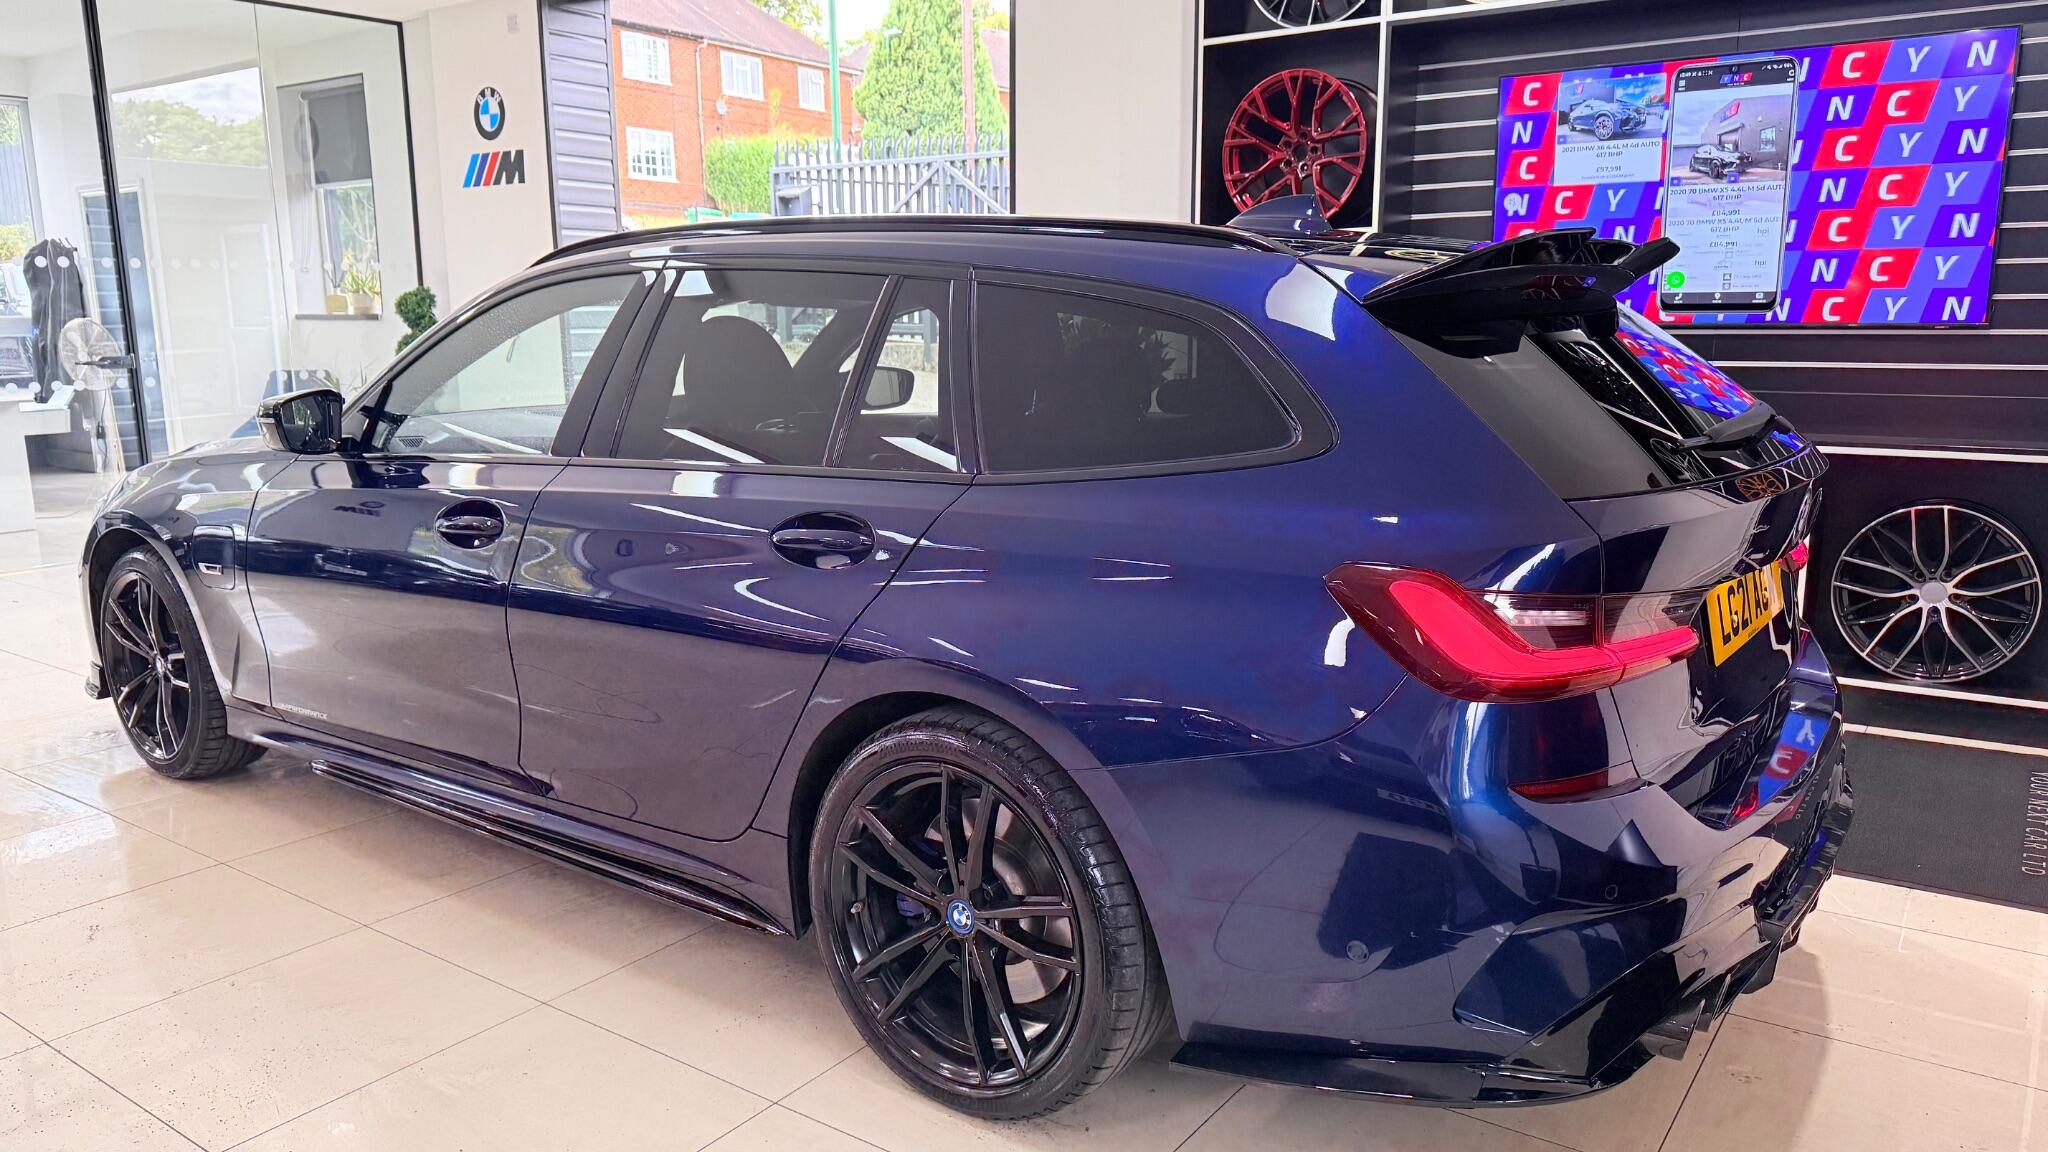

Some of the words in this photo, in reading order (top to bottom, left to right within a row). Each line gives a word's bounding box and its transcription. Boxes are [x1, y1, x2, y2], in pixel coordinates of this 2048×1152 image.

[1842, 51, 1865, 79] C
[1907, 45, 1931, 73] Y
[1966, 39, 1997, 68] N
[1523, 82, 1541, 106] C
[1826, 95, 1854, 121] N
[1887, 90, 1911, 117] C
[1954, 85, 1978, 112] Y
[1511, 121, 1533, 144] N
[1835, 135, 1858, 162] C
[1899, 131, 1922, 158] Y
[1958, 127, 1988, 154] N
[1519, 156, 1537, 180] C
[1819, 177, 1846, 203] N
[1879, 174, 1902, 200] C
[1945, 171, 1969, 197] Y
[1555, 191, 1573, 215] C
[1607, 188, 1626, 212] Y
[1829, 216, 1851, 242] C
[1891, 215, 1915, 240] Y
[1950, 212, 1979, 238] N
[1810, 258, 1838, 282] N
[1869, 256, 1893, 282] C
[1935, 255, 1959, 280] Y
[1822, 296, 1844, 322] C
[1885, 296, 1907, 321] Y
[1941, 296, 1971, 321] N
[1717, 575, 1752, 646] LG21
[2024, 827, 2048, 850] CAR
[2022, 852, 2047, 875] LTD
